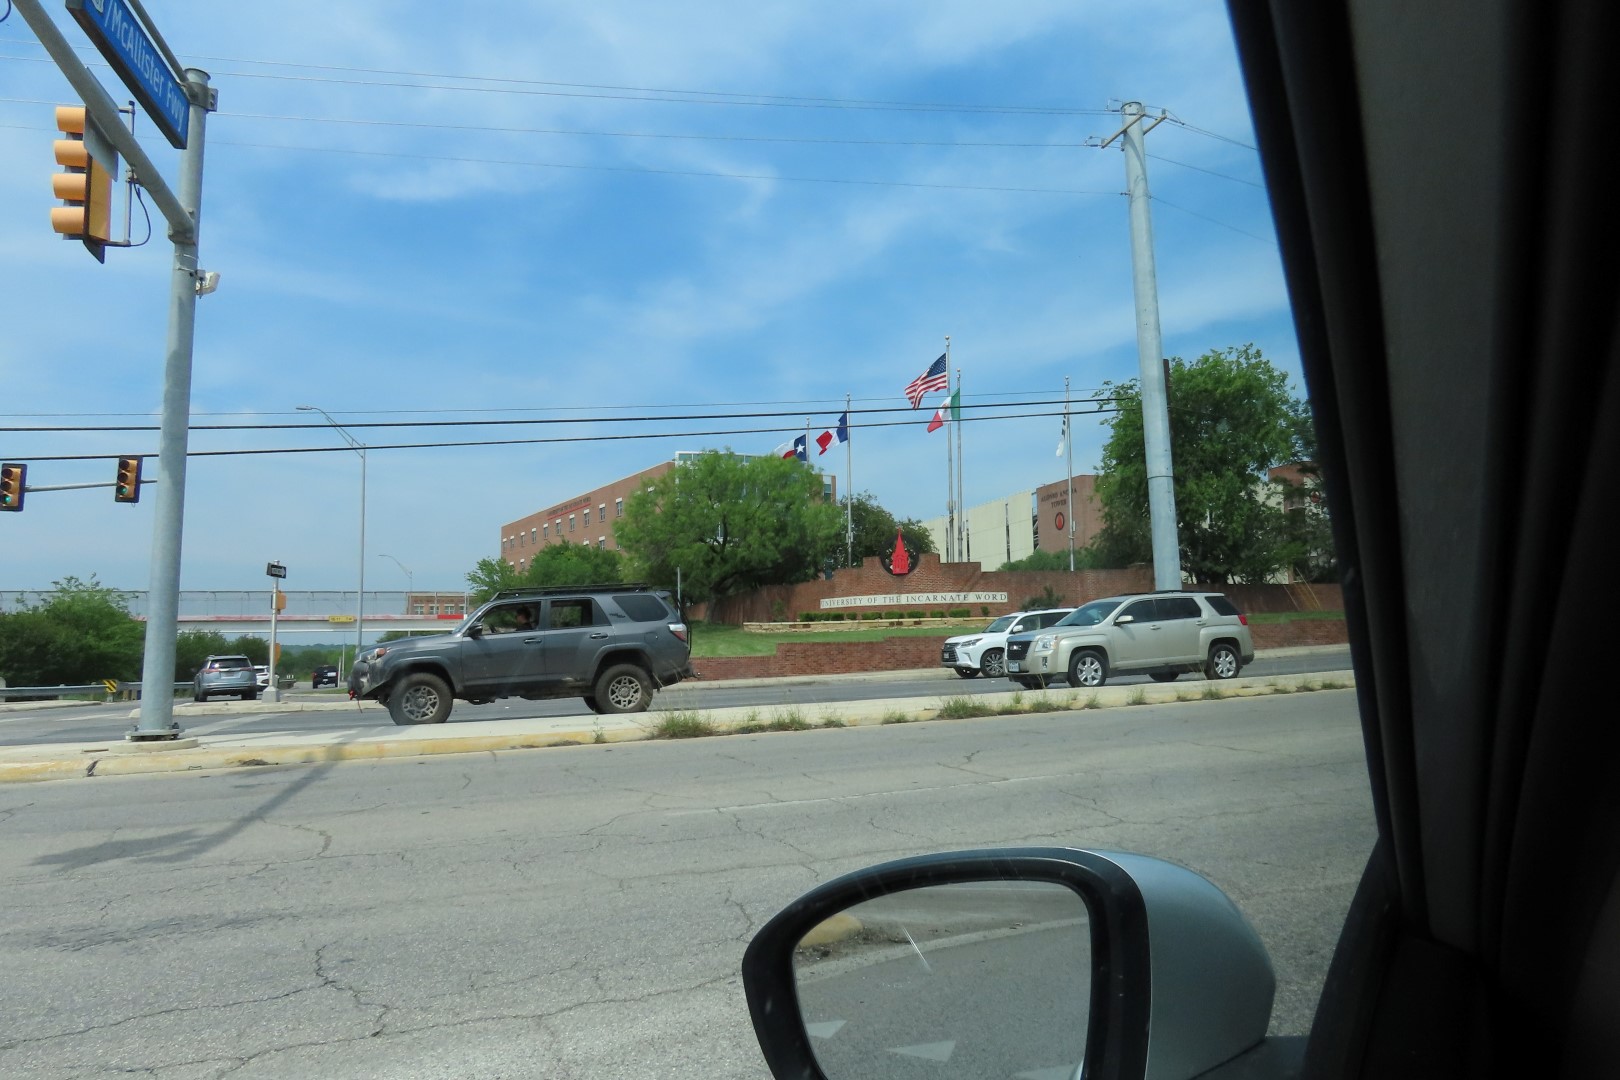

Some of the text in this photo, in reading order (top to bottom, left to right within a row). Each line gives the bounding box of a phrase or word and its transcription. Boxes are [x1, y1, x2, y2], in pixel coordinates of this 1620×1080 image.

[166, 81, 185, 132] Fwy
[883, 595, 902, 604] THE
[906, 594, 968, 602] INCARNATE
[975, 593, 1007, 601] WORD
